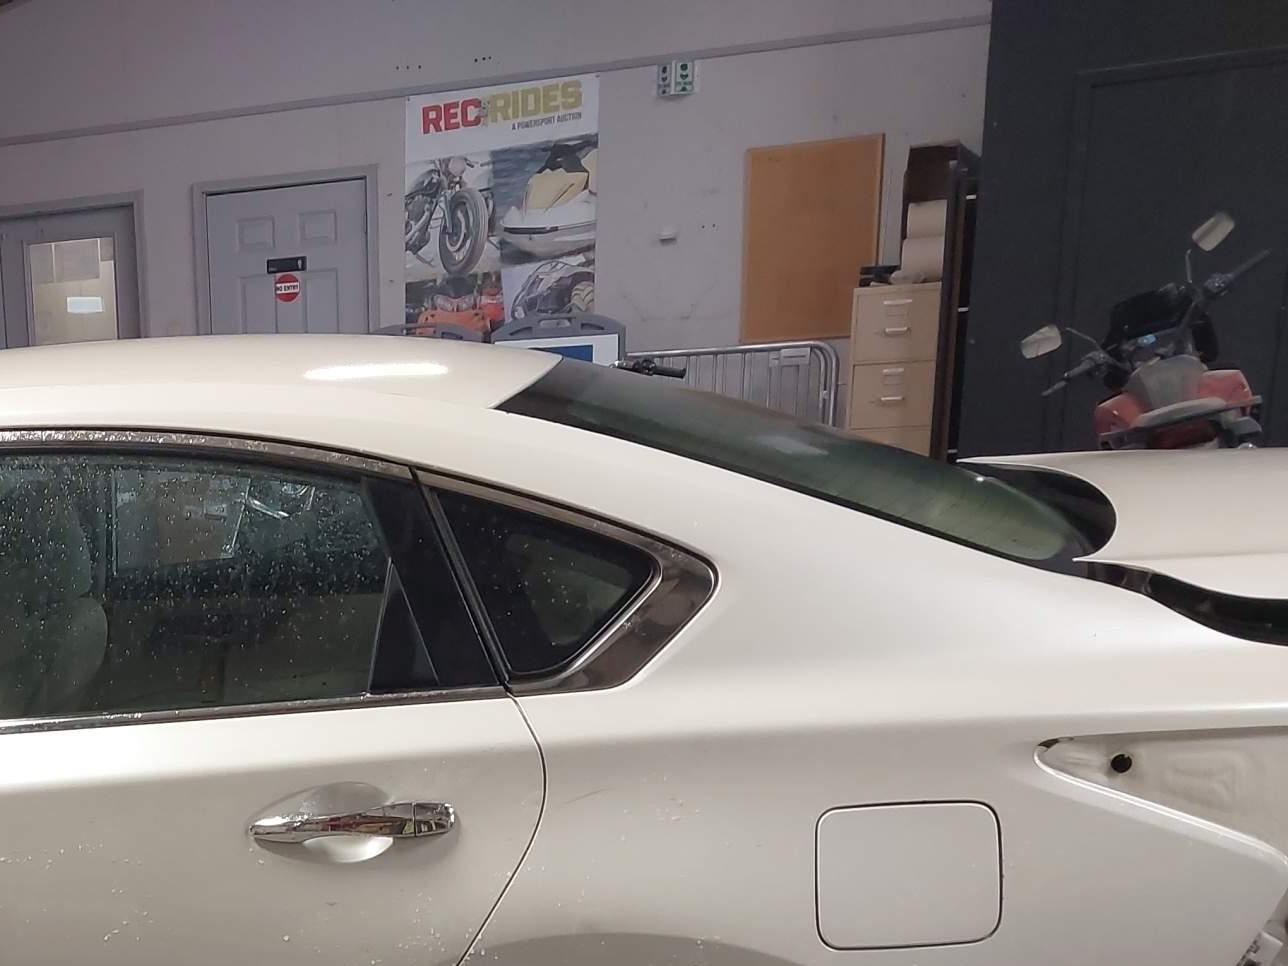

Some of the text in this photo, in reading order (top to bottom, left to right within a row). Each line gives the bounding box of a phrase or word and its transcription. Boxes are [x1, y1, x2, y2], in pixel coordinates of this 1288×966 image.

[422, 98, 483, 135] REC
[488, 79, 583, 123] RIDES
[556, 111, 582, 123] AUCTION
[283, 284, 299, 292] ENTRY
